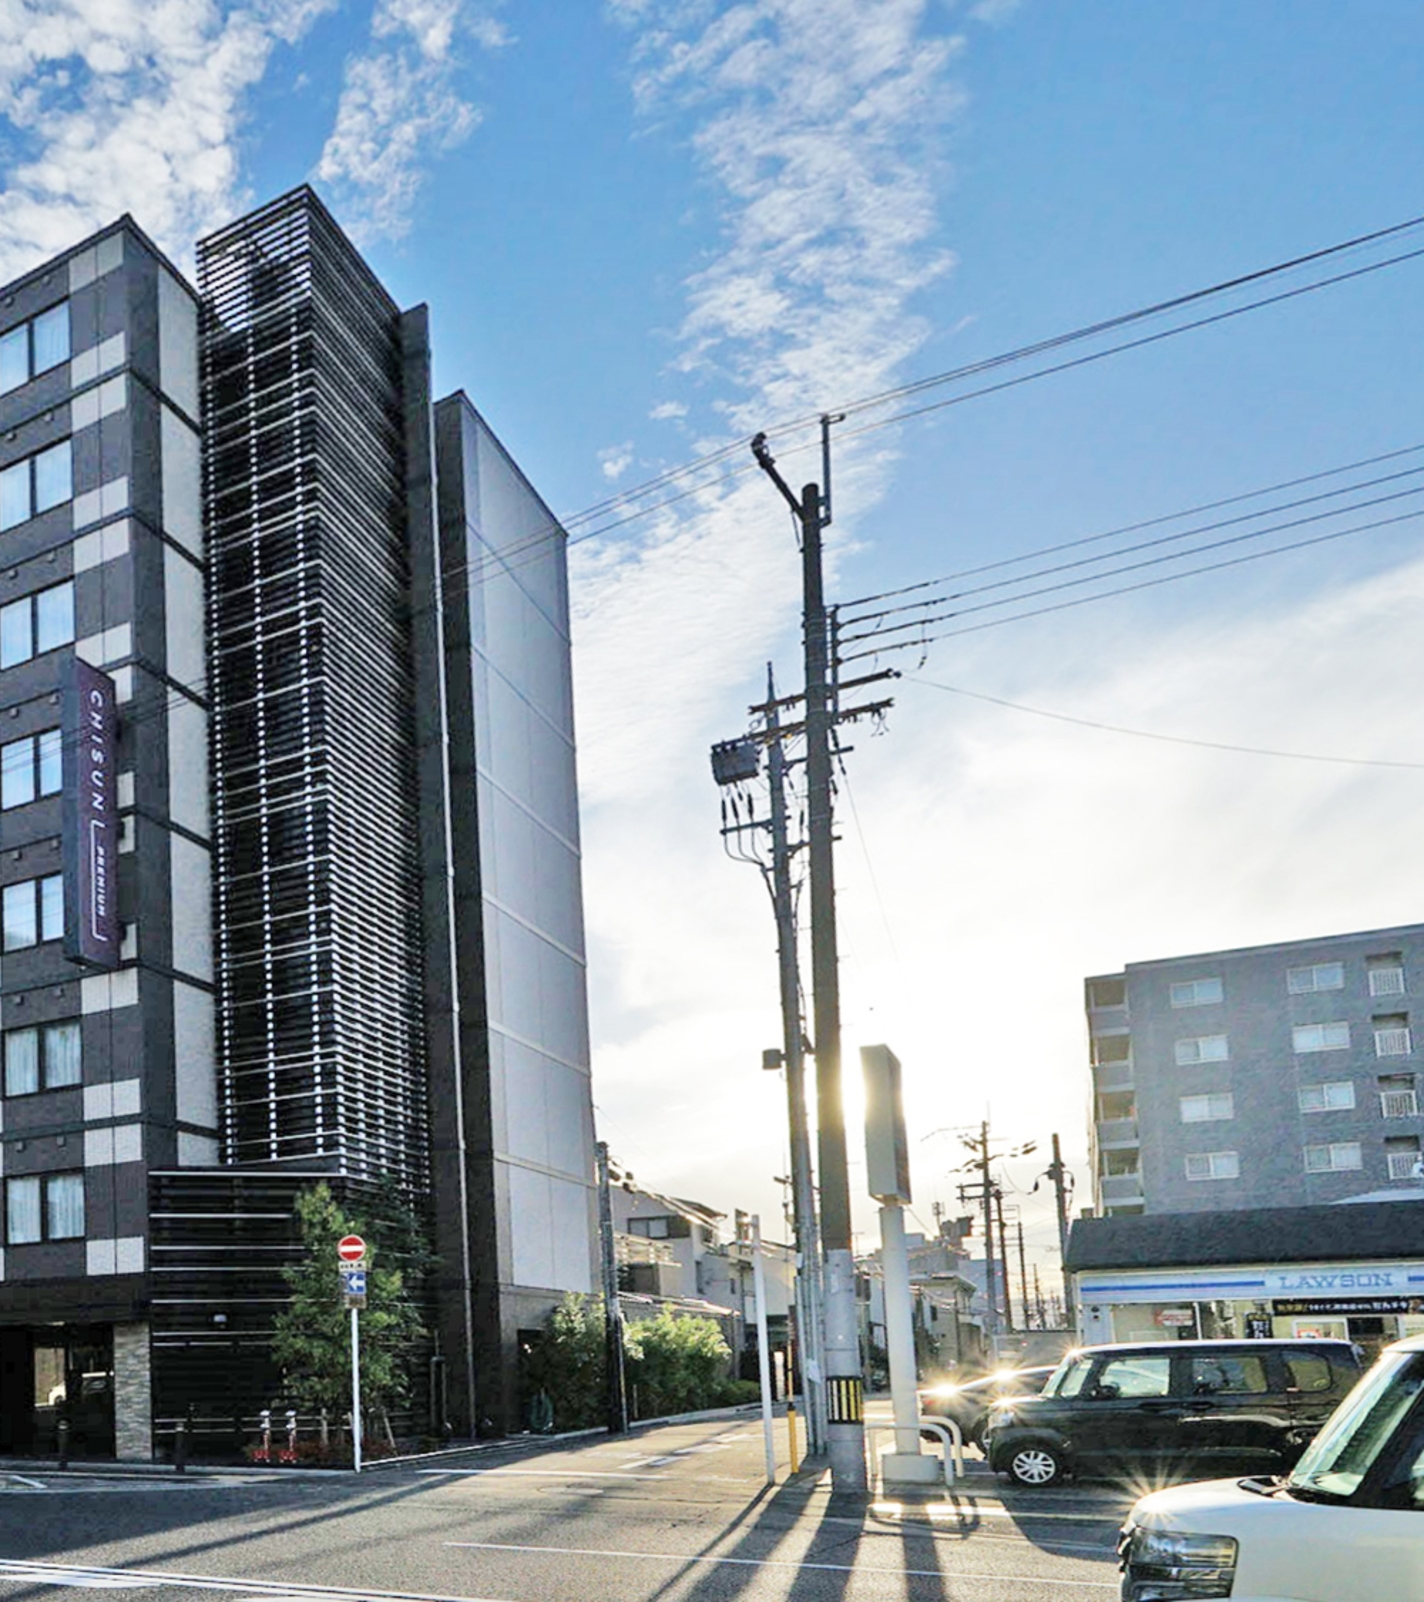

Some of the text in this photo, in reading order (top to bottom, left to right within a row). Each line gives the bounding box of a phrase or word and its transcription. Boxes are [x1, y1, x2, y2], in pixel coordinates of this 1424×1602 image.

[90, 690, 104, 811] CHISUN
[96, 845, 106, 917] PREMIUM
[1278, 1272, 1393, 1290] LAWSON
